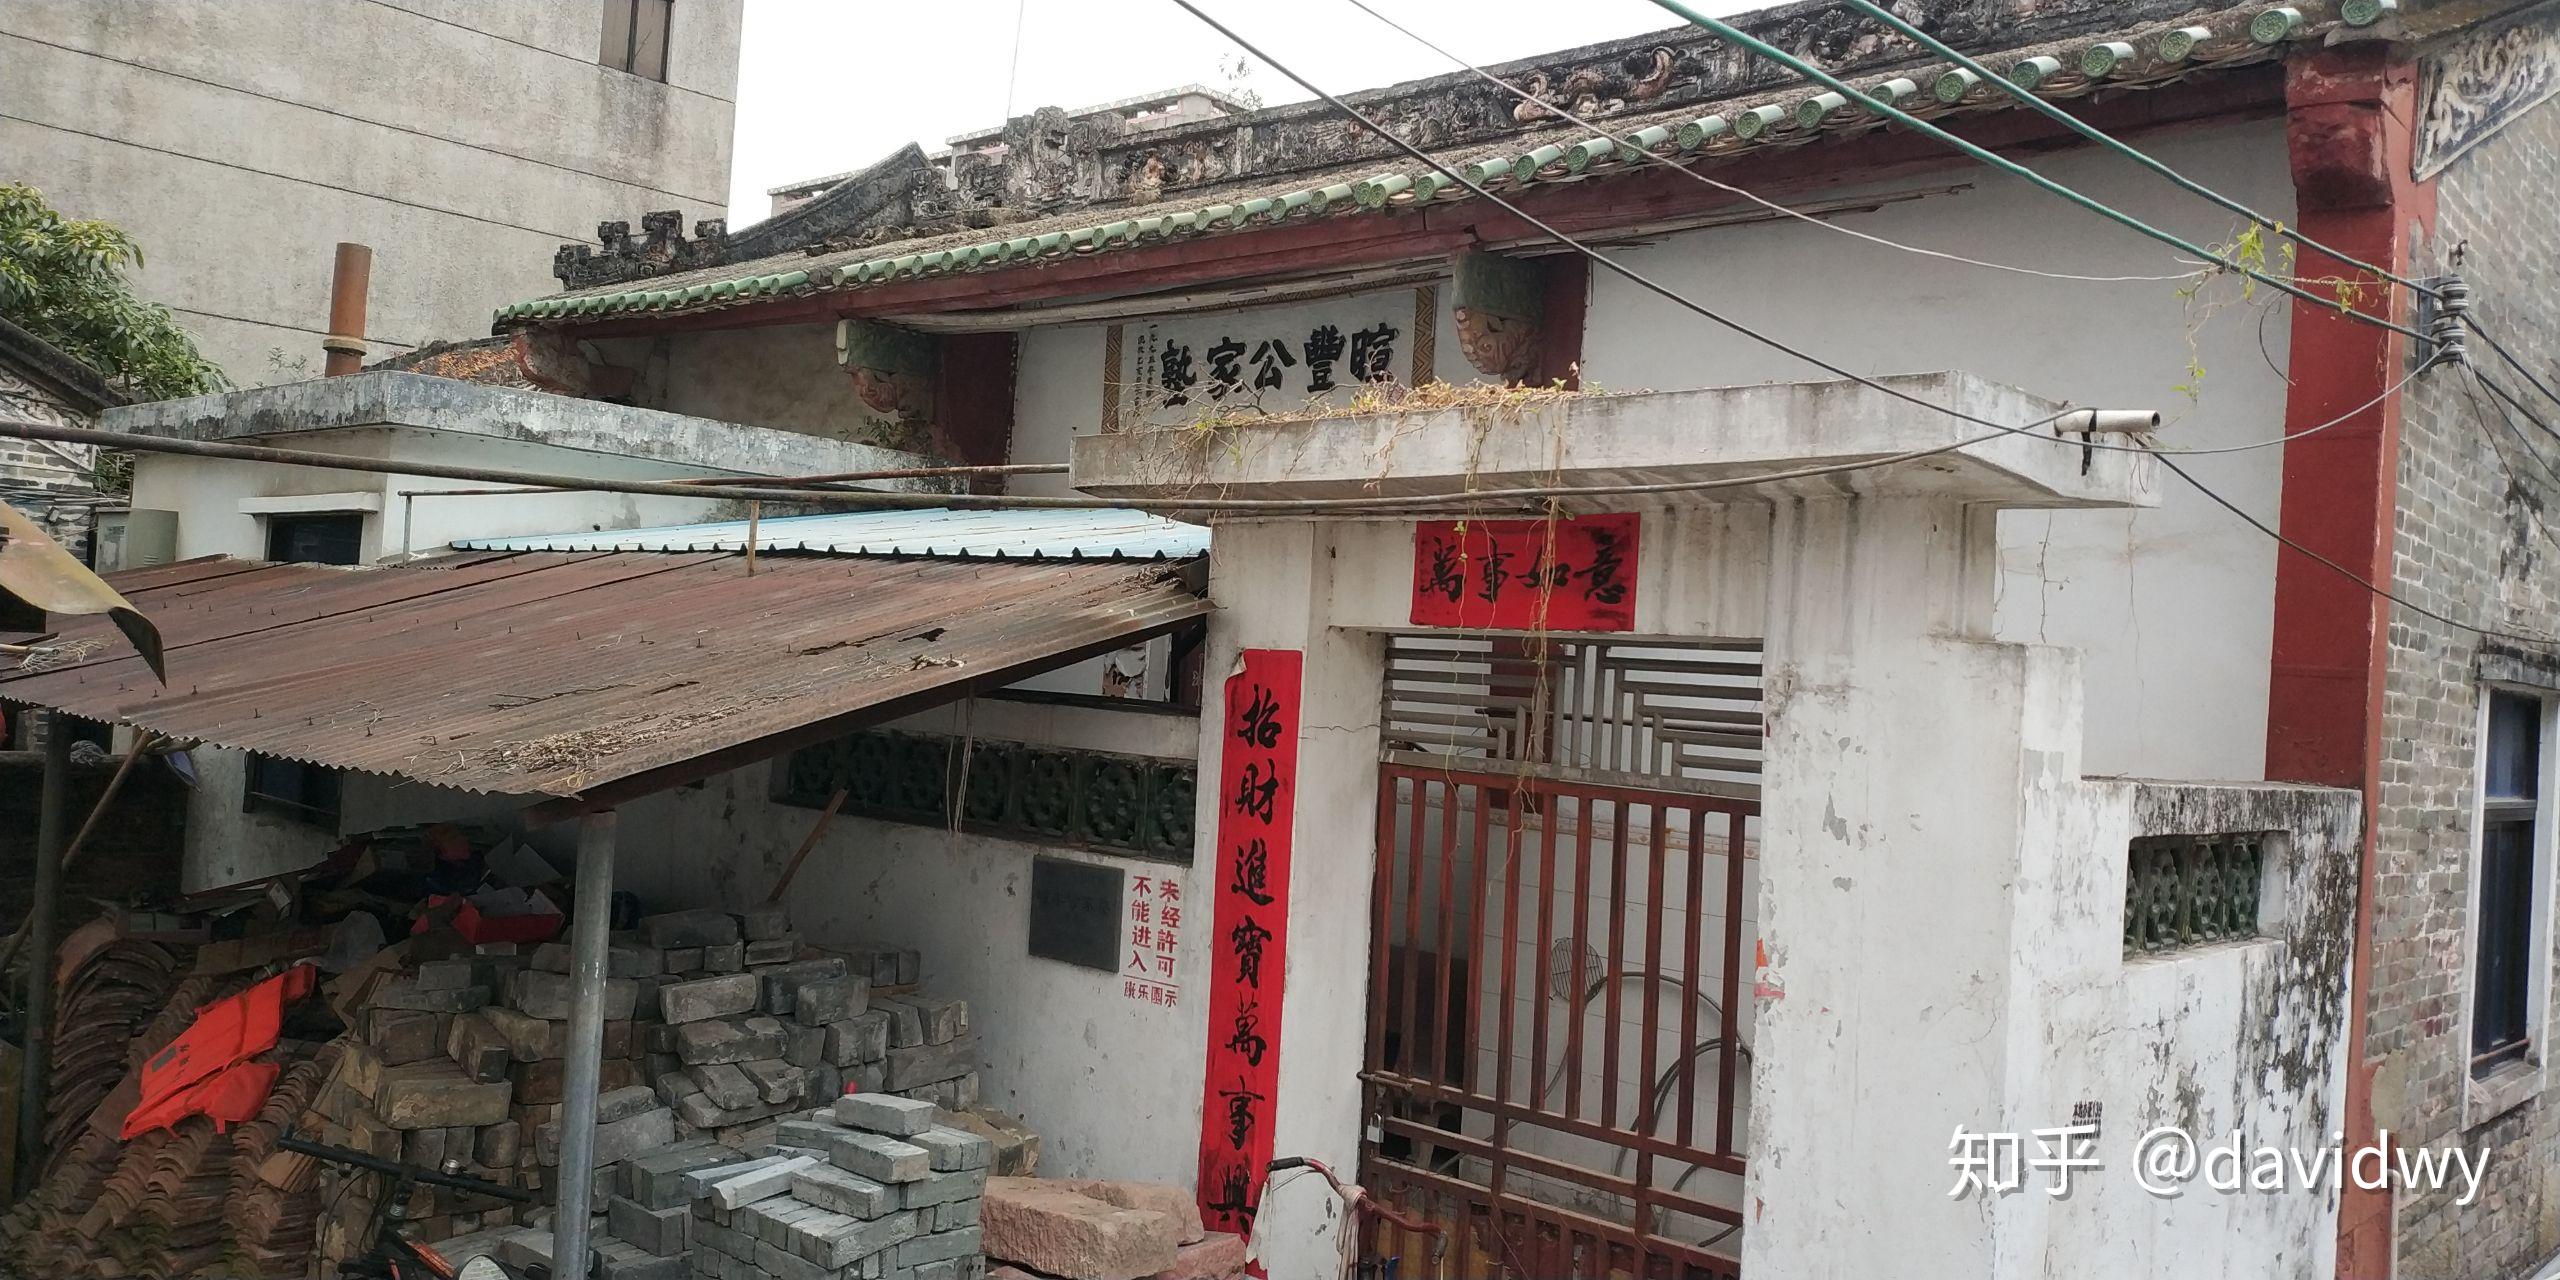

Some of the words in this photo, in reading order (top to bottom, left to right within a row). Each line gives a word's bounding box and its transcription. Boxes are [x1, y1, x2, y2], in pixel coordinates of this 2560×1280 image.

[1420, 526, 1628, 604] 萬事如意
[1128, 875, 1153, 974] 不能进入
